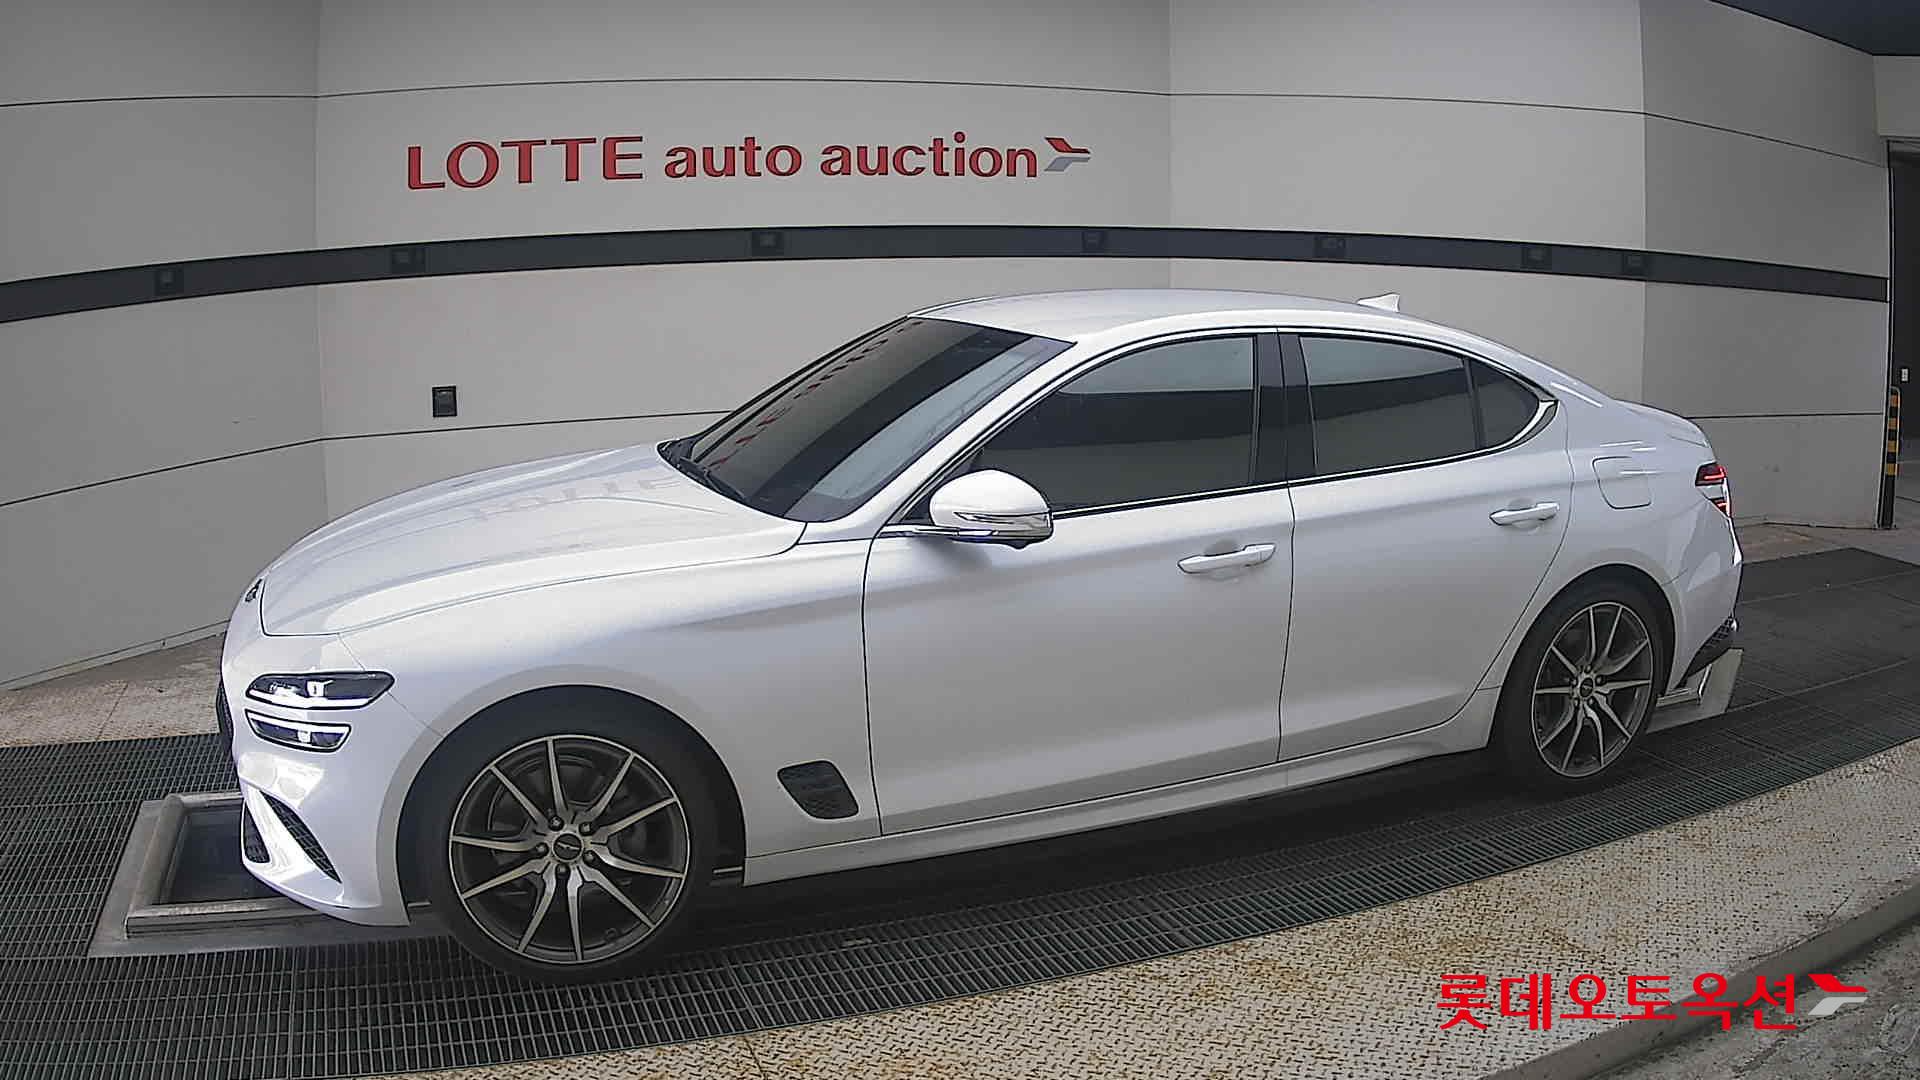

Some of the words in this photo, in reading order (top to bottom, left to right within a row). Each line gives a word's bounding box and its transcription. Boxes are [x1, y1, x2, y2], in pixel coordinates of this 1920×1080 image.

[407, 136, 643, 190] LOTTE
[664, 136, 802, 178] auto
[819, 131, 1038, 178] auction
